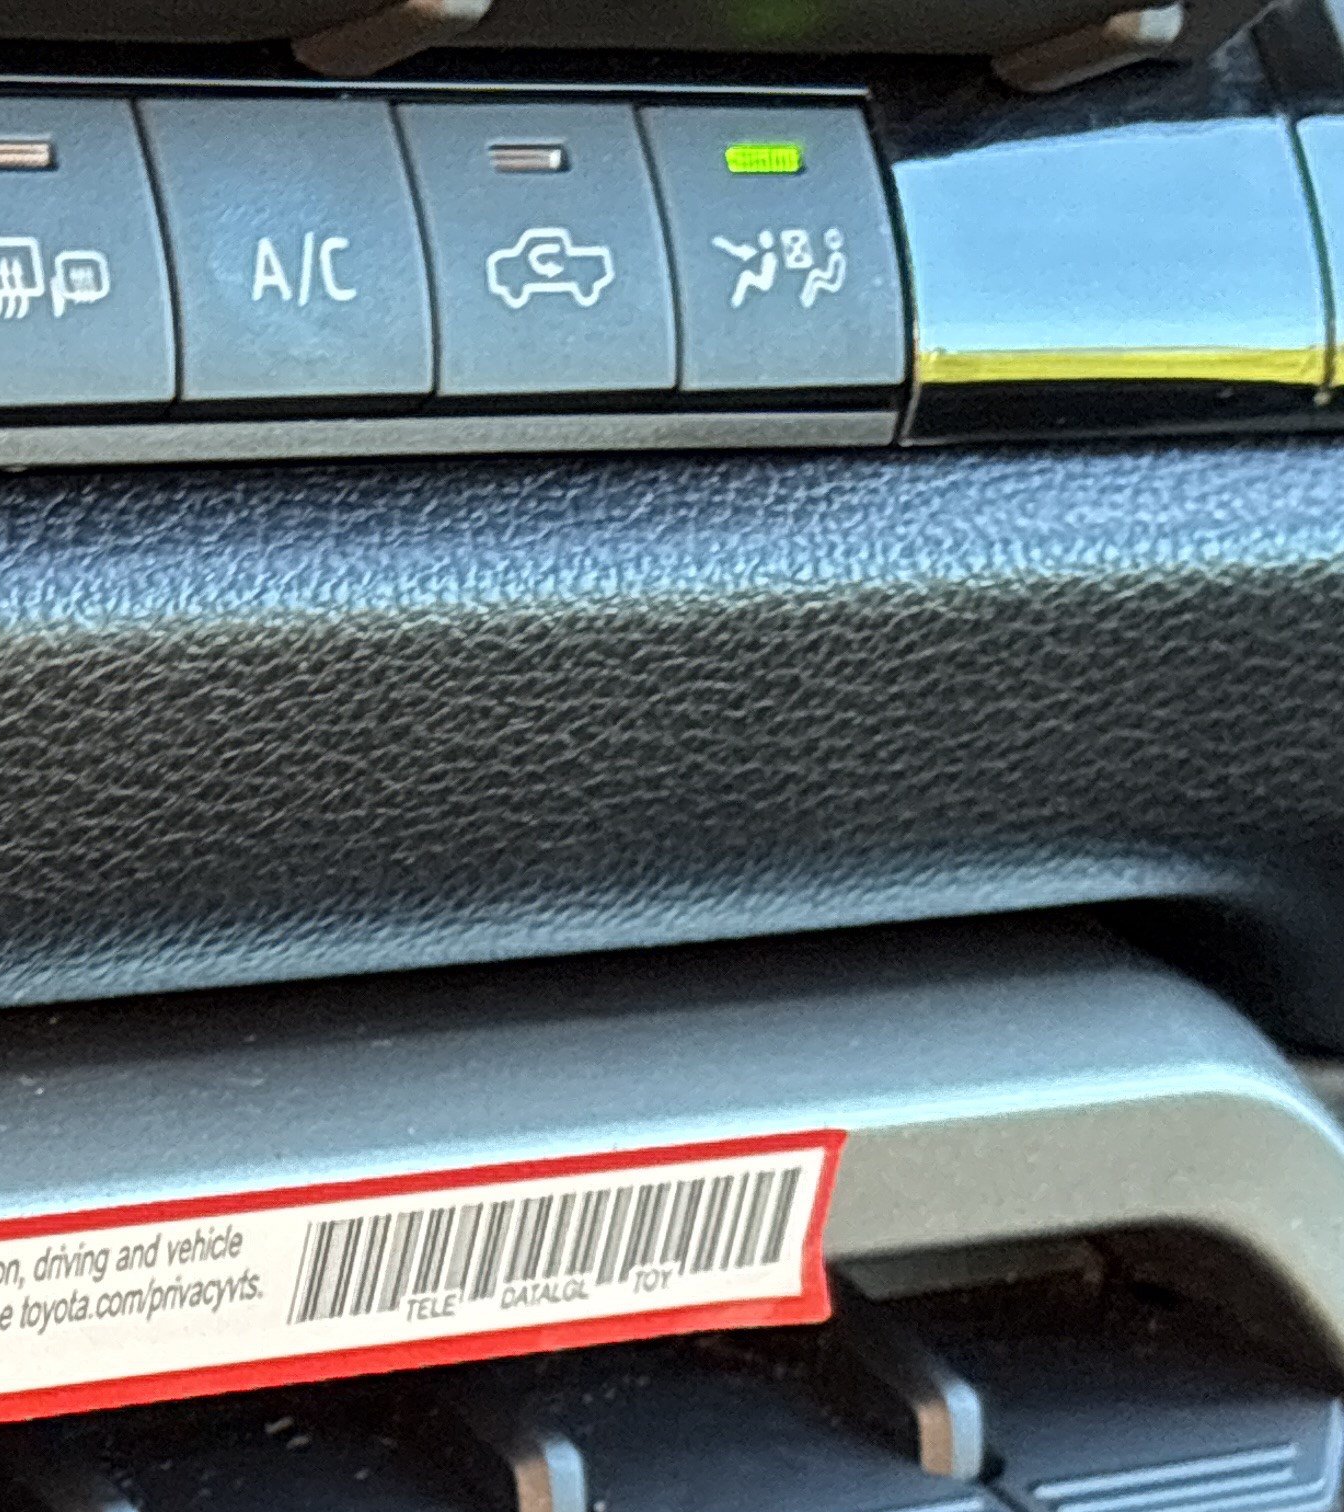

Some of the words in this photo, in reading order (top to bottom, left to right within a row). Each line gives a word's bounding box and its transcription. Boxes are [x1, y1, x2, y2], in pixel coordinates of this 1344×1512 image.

[252, 232, 359, 306] A/C
[34, 1240, 110, 1284] driving
[116, 1233, 161, 1271] and
[167, 1224, 243, 1264] vehicle
[20, 1268, 265, 1335] toyota.com/privacyvts.
[407, 1293, 456, 1321] TELE
